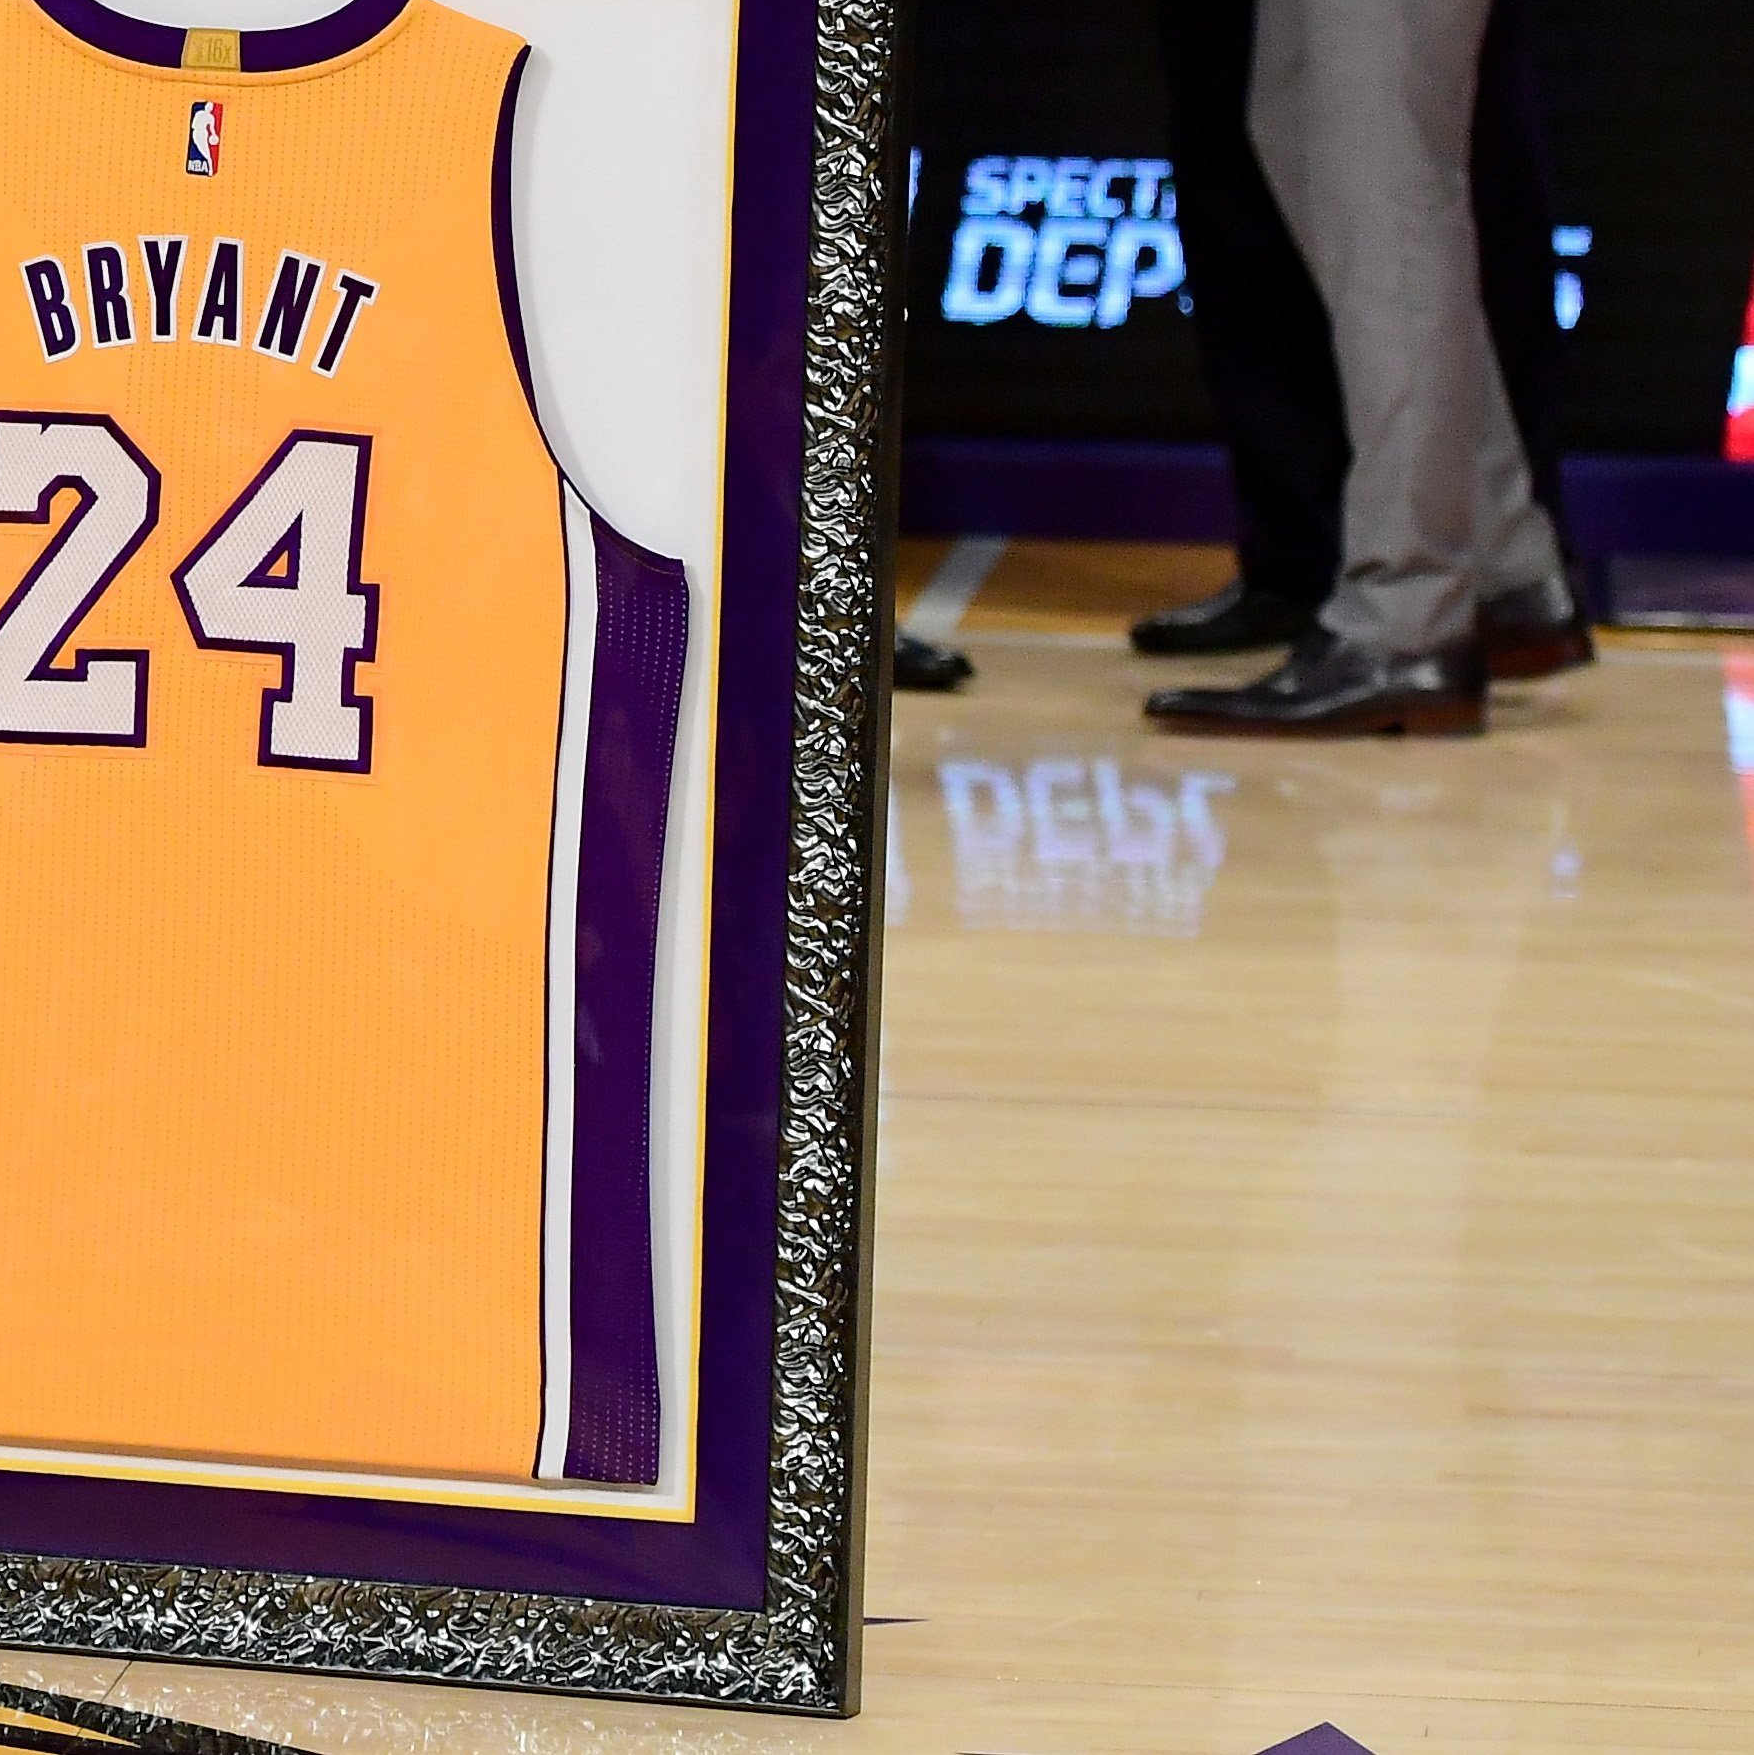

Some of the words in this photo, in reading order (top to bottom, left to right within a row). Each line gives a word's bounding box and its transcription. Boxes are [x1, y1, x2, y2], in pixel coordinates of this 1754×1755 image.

[187, 158, 209, 173] NBA
[960, 155, 1177, 218] SPECT
[21, 234, 380, 377] BRYANT
[940, 216, 1192, 331] DEP
